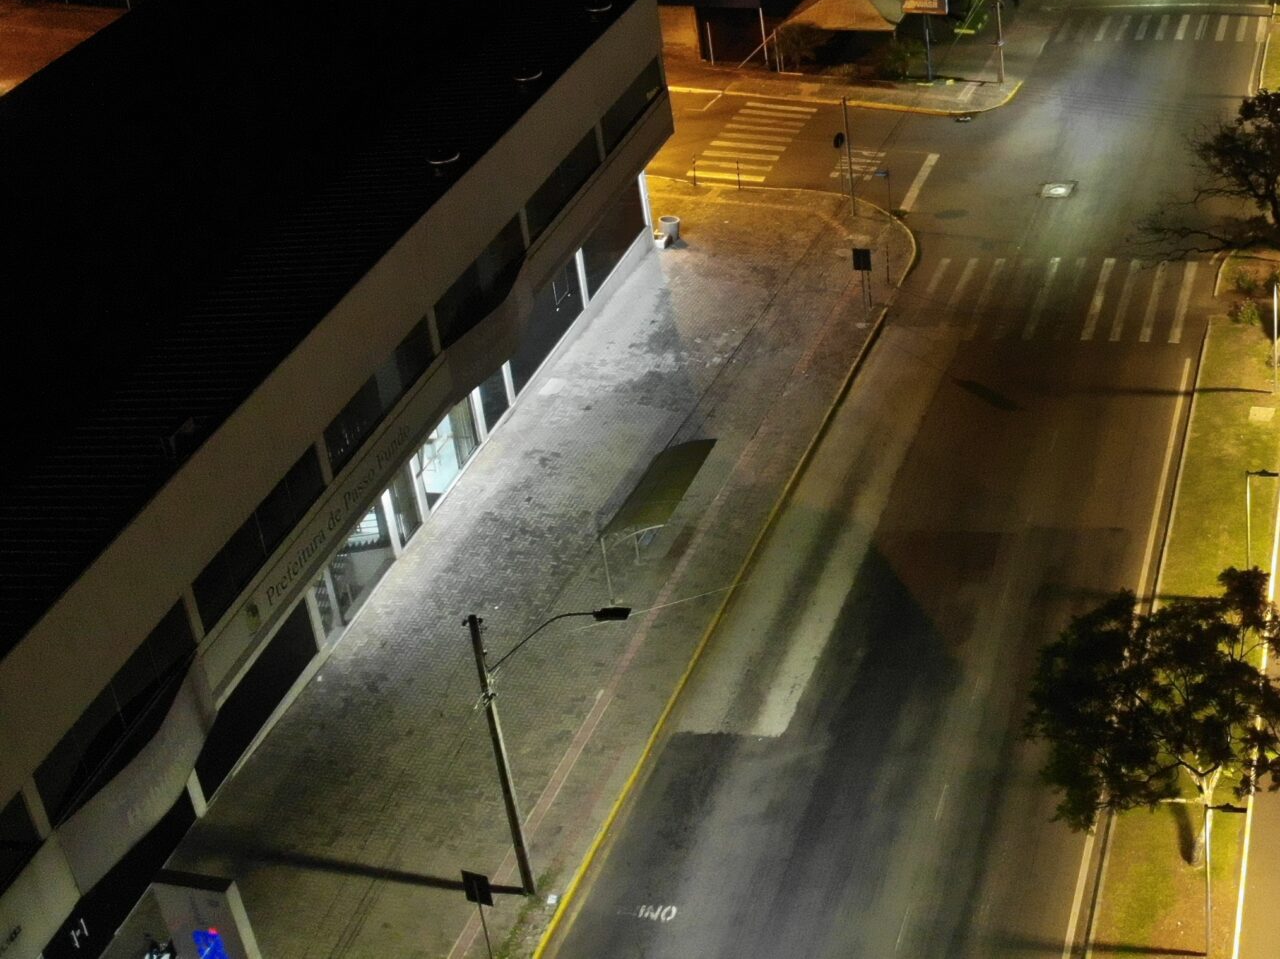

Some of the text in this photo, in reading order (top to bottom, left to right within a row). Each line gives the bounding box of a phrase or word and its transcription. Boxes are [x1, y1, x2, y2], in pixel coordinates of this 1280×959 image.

[265, 527, 324, 606] Prefeitura
[327, 506, 342, 531] de
[343, 469, 375, 512] Passo
